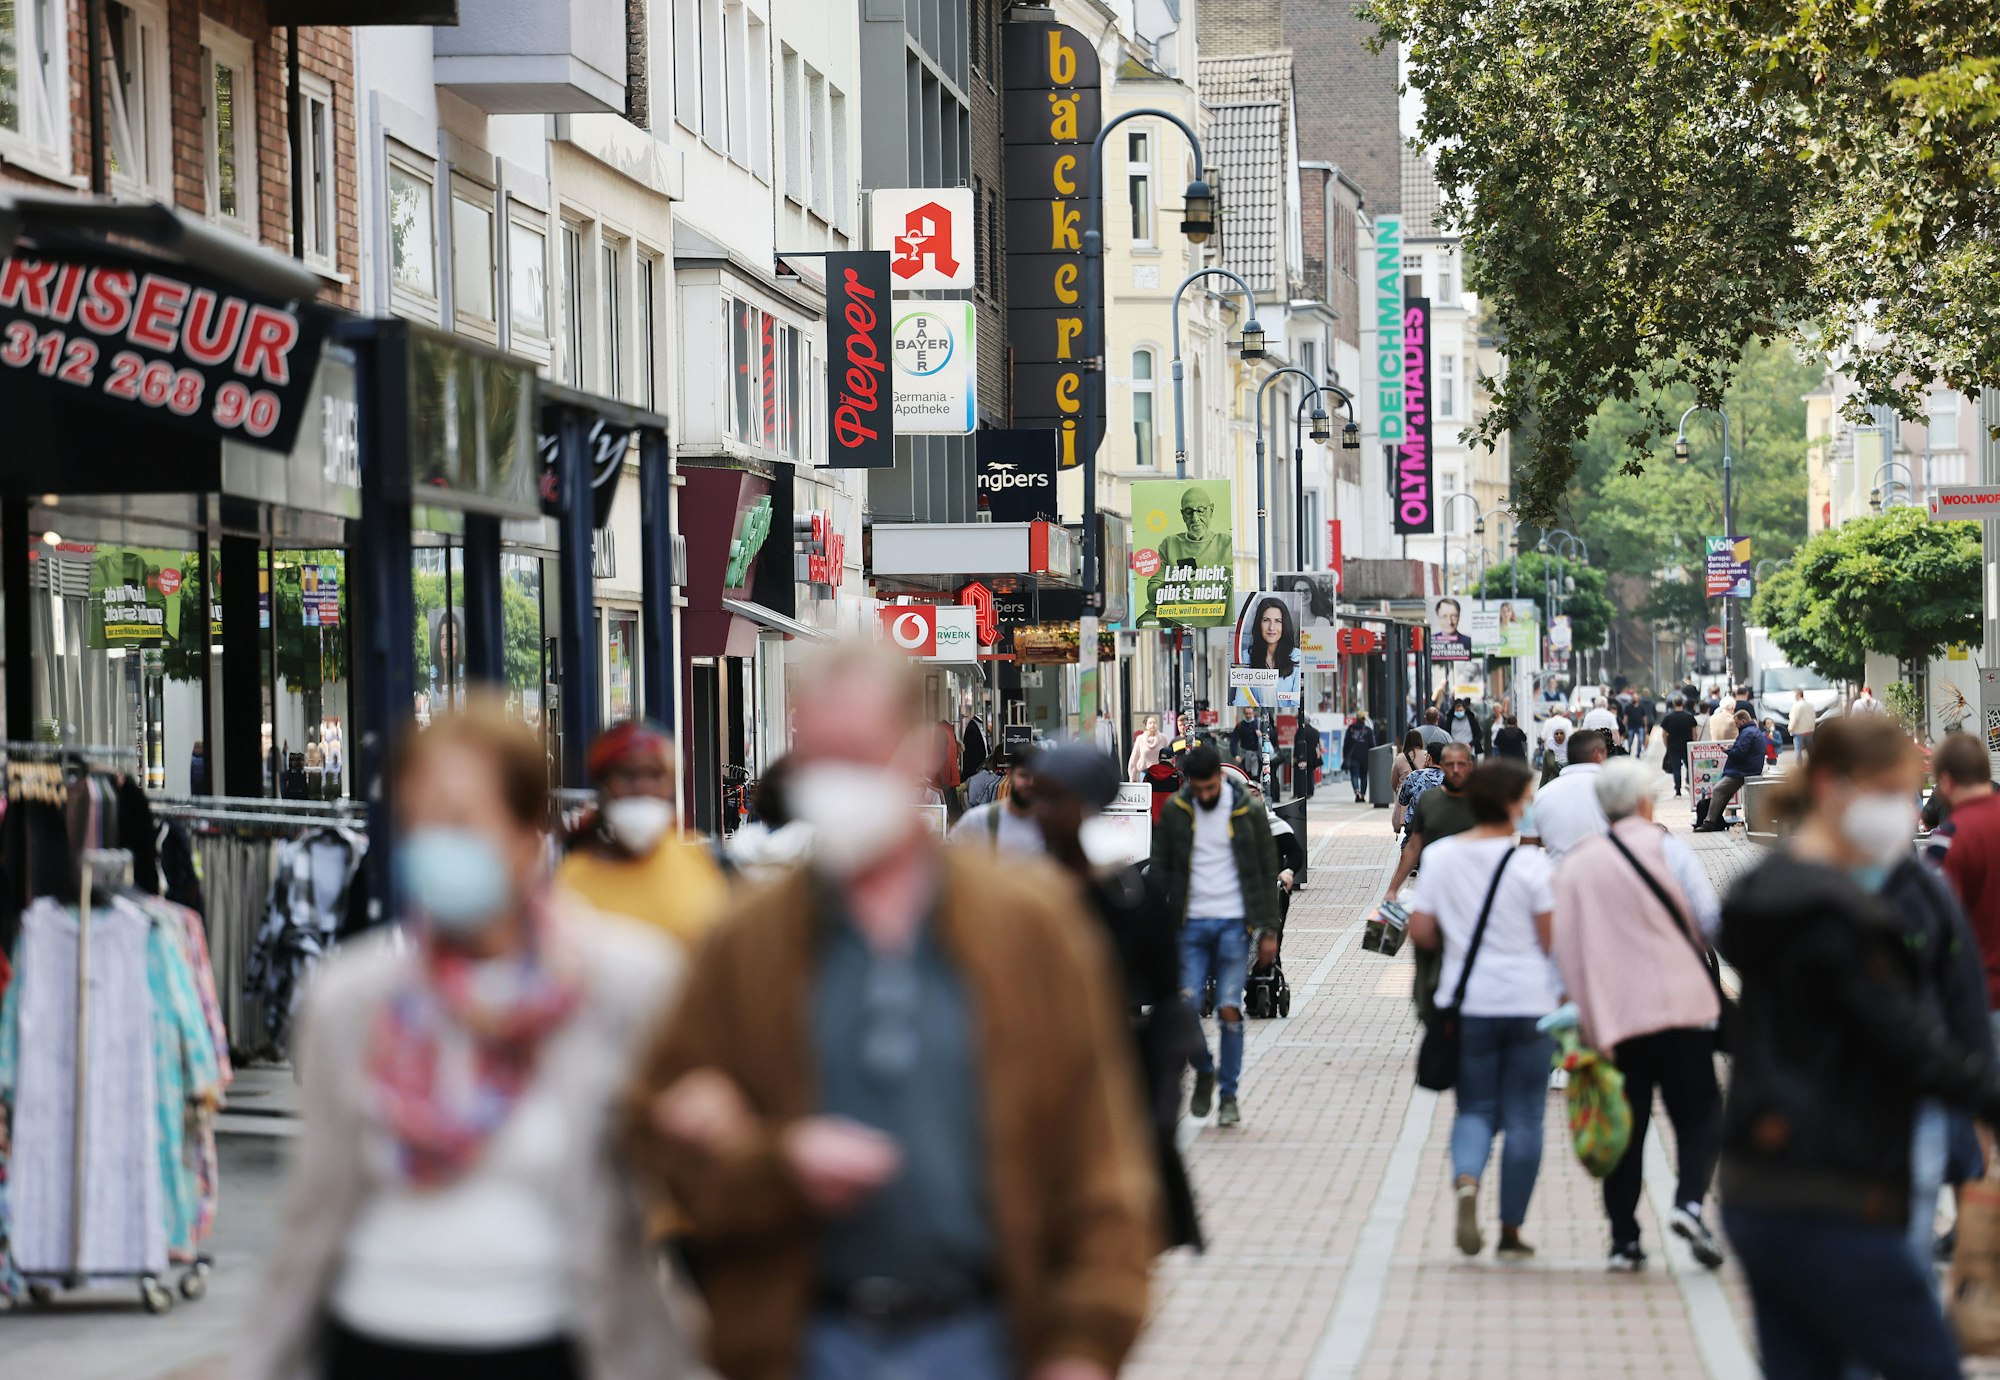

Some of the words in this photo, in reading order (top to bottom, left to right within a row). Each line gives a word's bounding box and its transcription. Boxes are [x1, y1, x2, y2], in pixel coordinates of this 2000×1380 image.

[1048, 30, 1084, 467] bäckerei
[0, 255, 299, 387] RISEUR
[1377, 221, 1402, 439] DEICHMANN
[895, 339, 948, 350] BAYER
[834, 267, 886, 449] Pieper
[0, 320, 99, 389] 312
[103, 350, 206, 417] 268
[211, 380, 281, 438] 90
[894, 403, 950, 416] Apotheke
[1708, 539, 1735, 551] Volt
[1164, 564, 1193, 582] Lädt
[1194, 564, 1228, 583] nicht,
[1193, 584, 1227, 600] nicht.
[1179, 607, 1191, 616] weil
[1231, 671, 1254, 681] Serap
[1255, 671, 1277, 680] Güler
[1118, 793, 1146, 803] Nails
